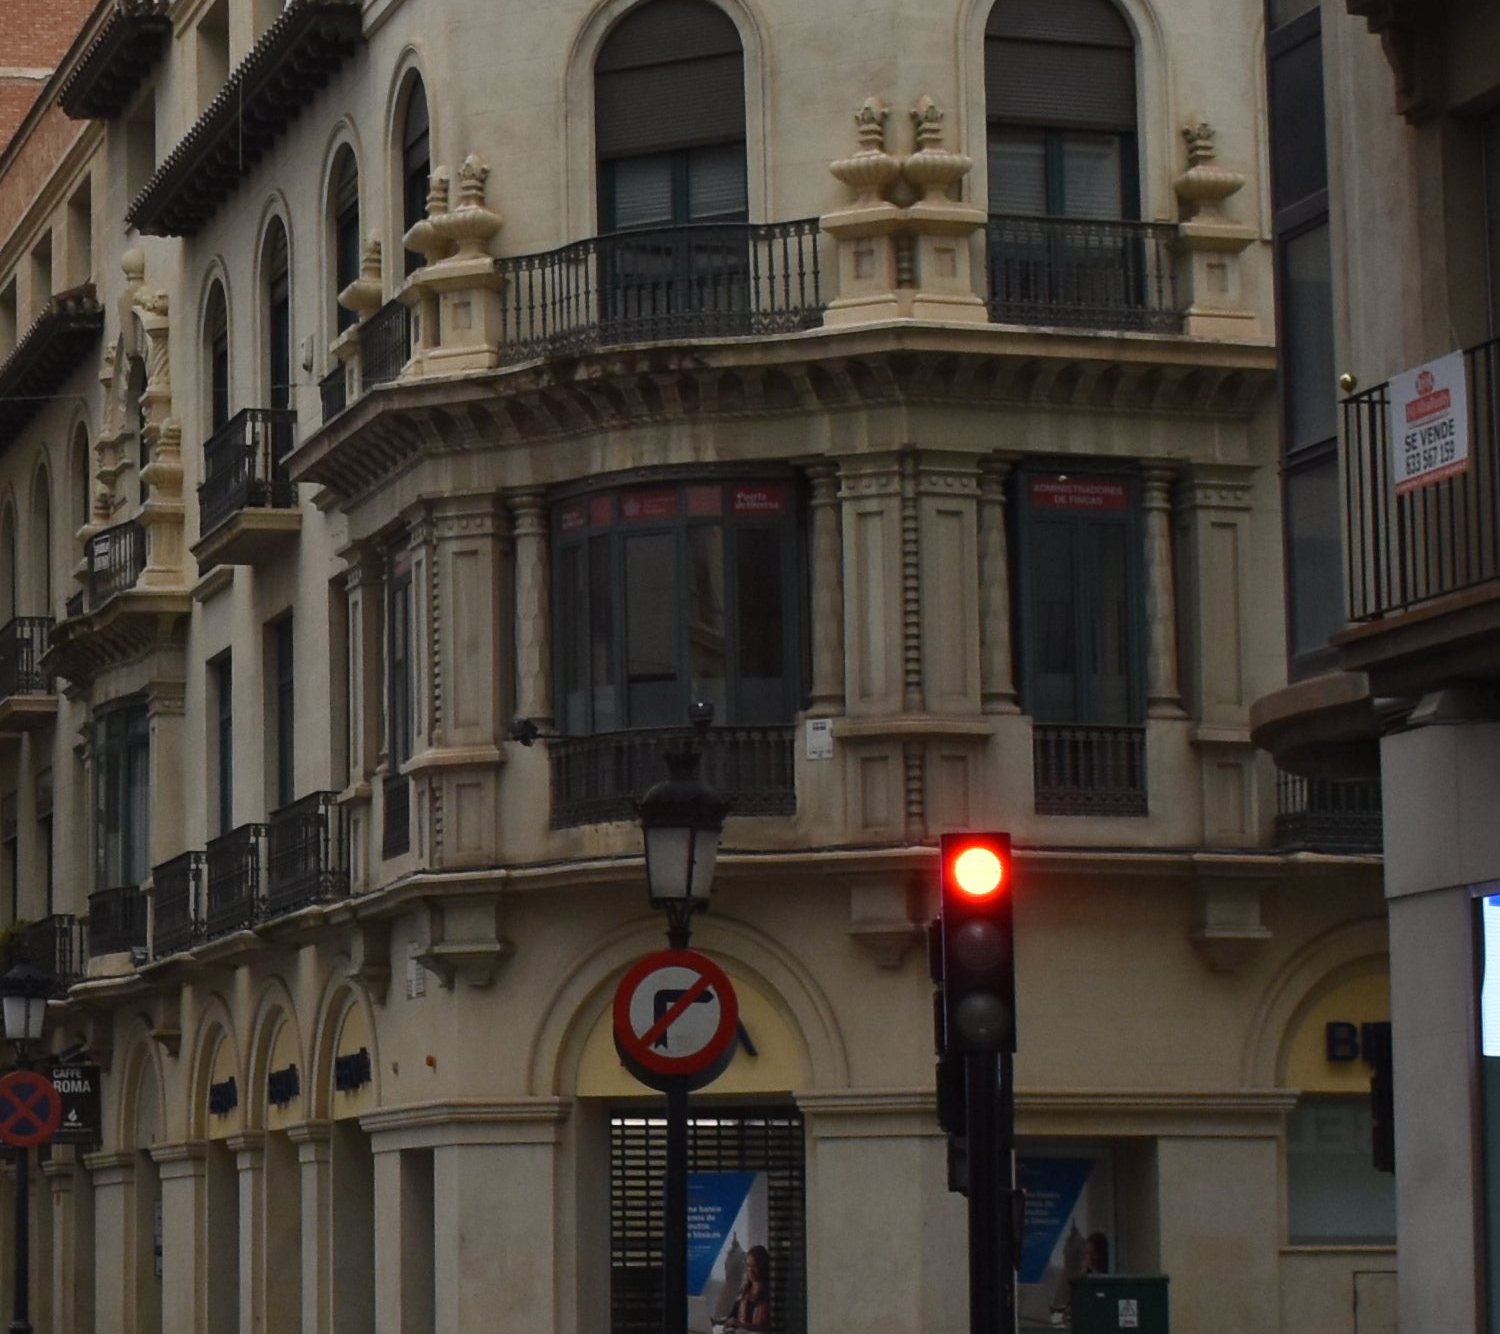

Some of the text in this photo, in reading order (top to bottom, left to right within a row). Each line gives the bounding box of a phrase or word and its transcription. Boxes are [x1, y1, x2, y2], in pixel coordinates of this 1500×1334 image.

[1404, 418, 1456, 453] SE VENDE
[53, 1080, 92, 1093] ROMA
